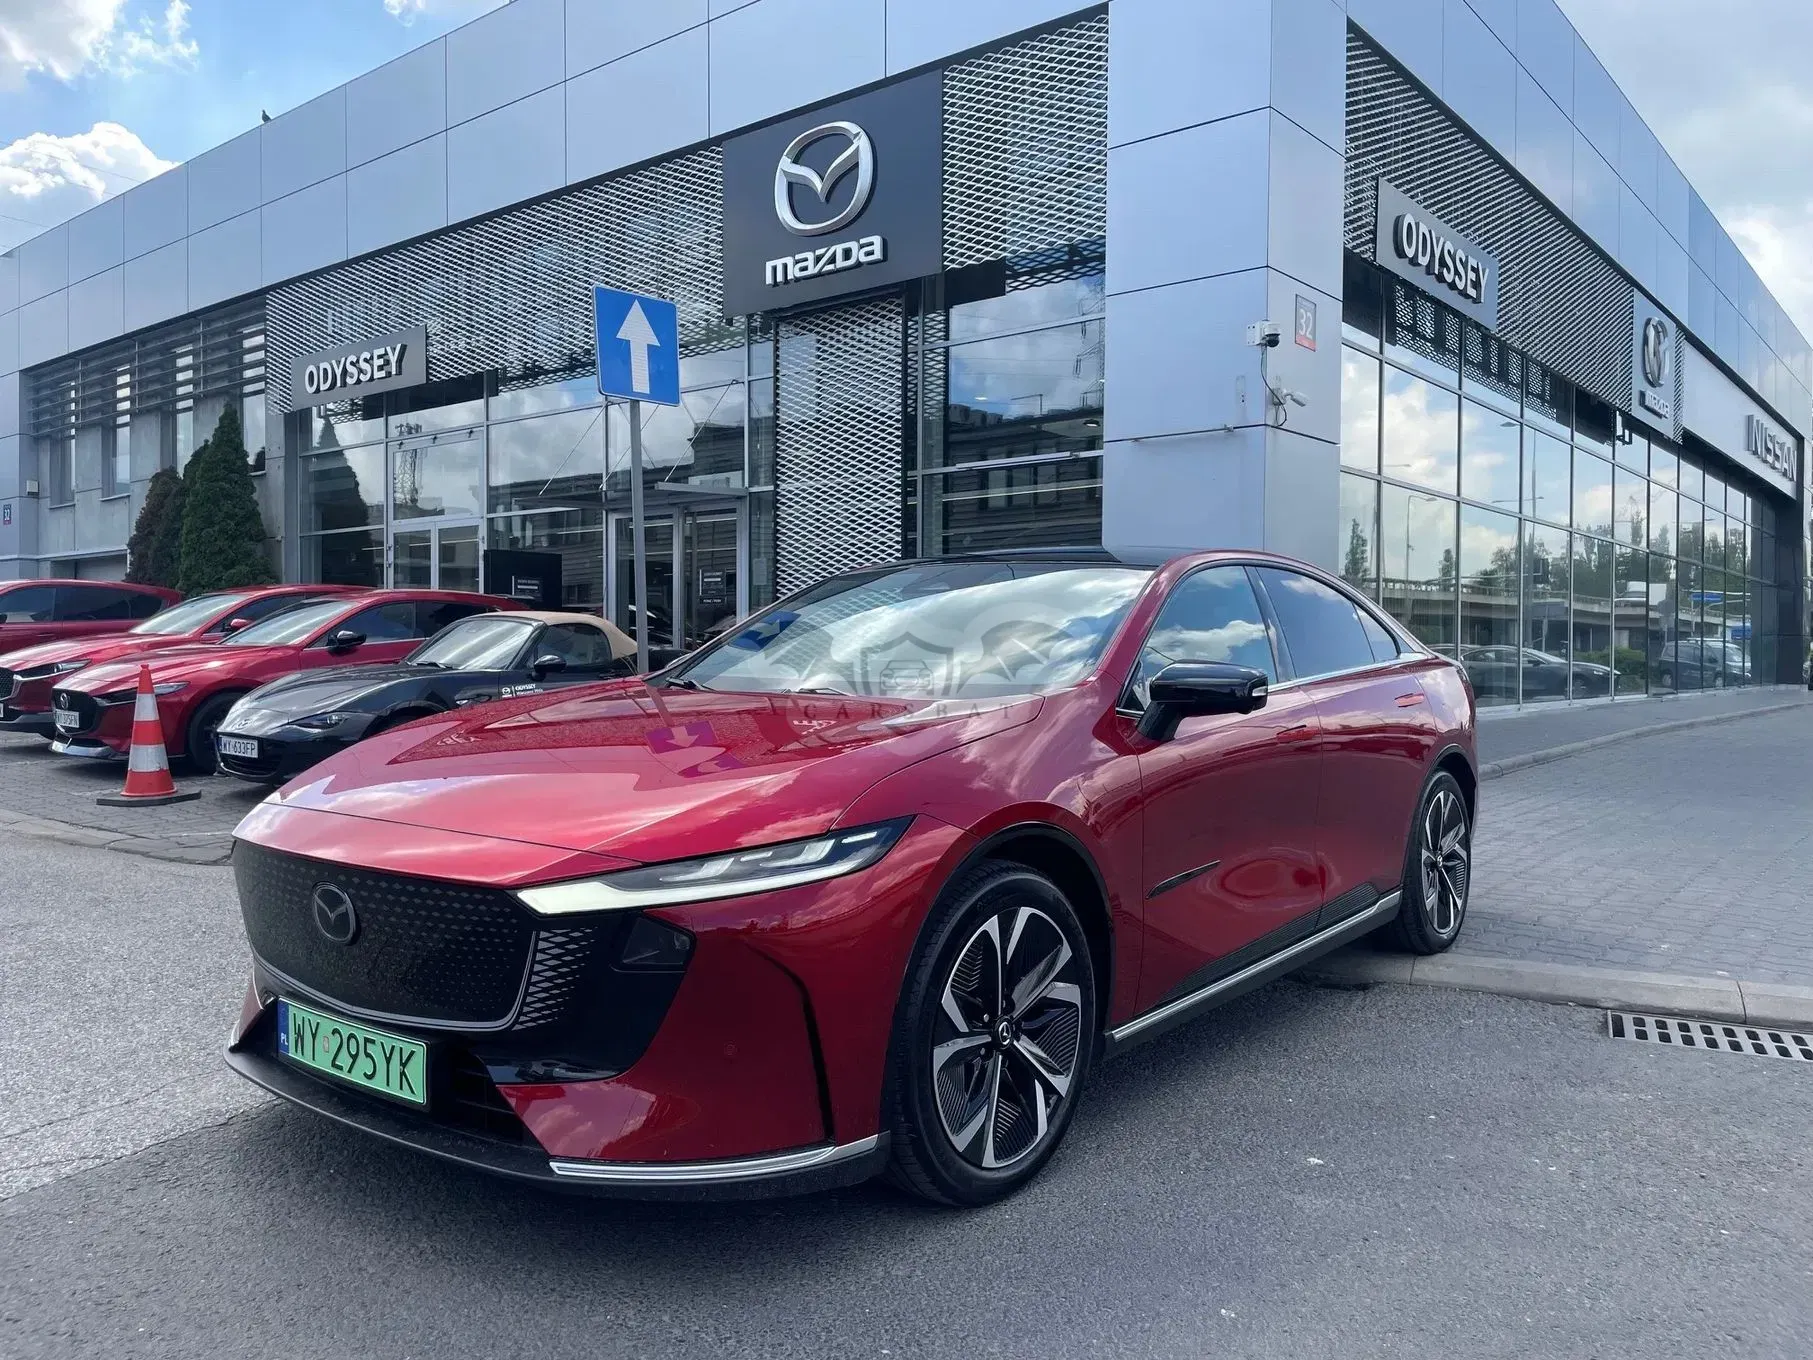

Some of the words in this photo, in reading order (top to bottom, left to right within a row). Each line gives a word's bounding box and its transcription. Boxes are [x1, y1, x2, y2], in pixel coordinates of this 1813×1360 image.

[1393, 212, 1489, 304] ODYSSEY
[1299, 308, 1313, 341] 32
[304, 343, 405, 394] ODYSSEY
[1746, 414, 1797, 483] NISSAN
[280, 1032, 289, 1046] PL
[293, 1012, 321, 1062] WY
[330, 1027, 417, 1096] 295YK
